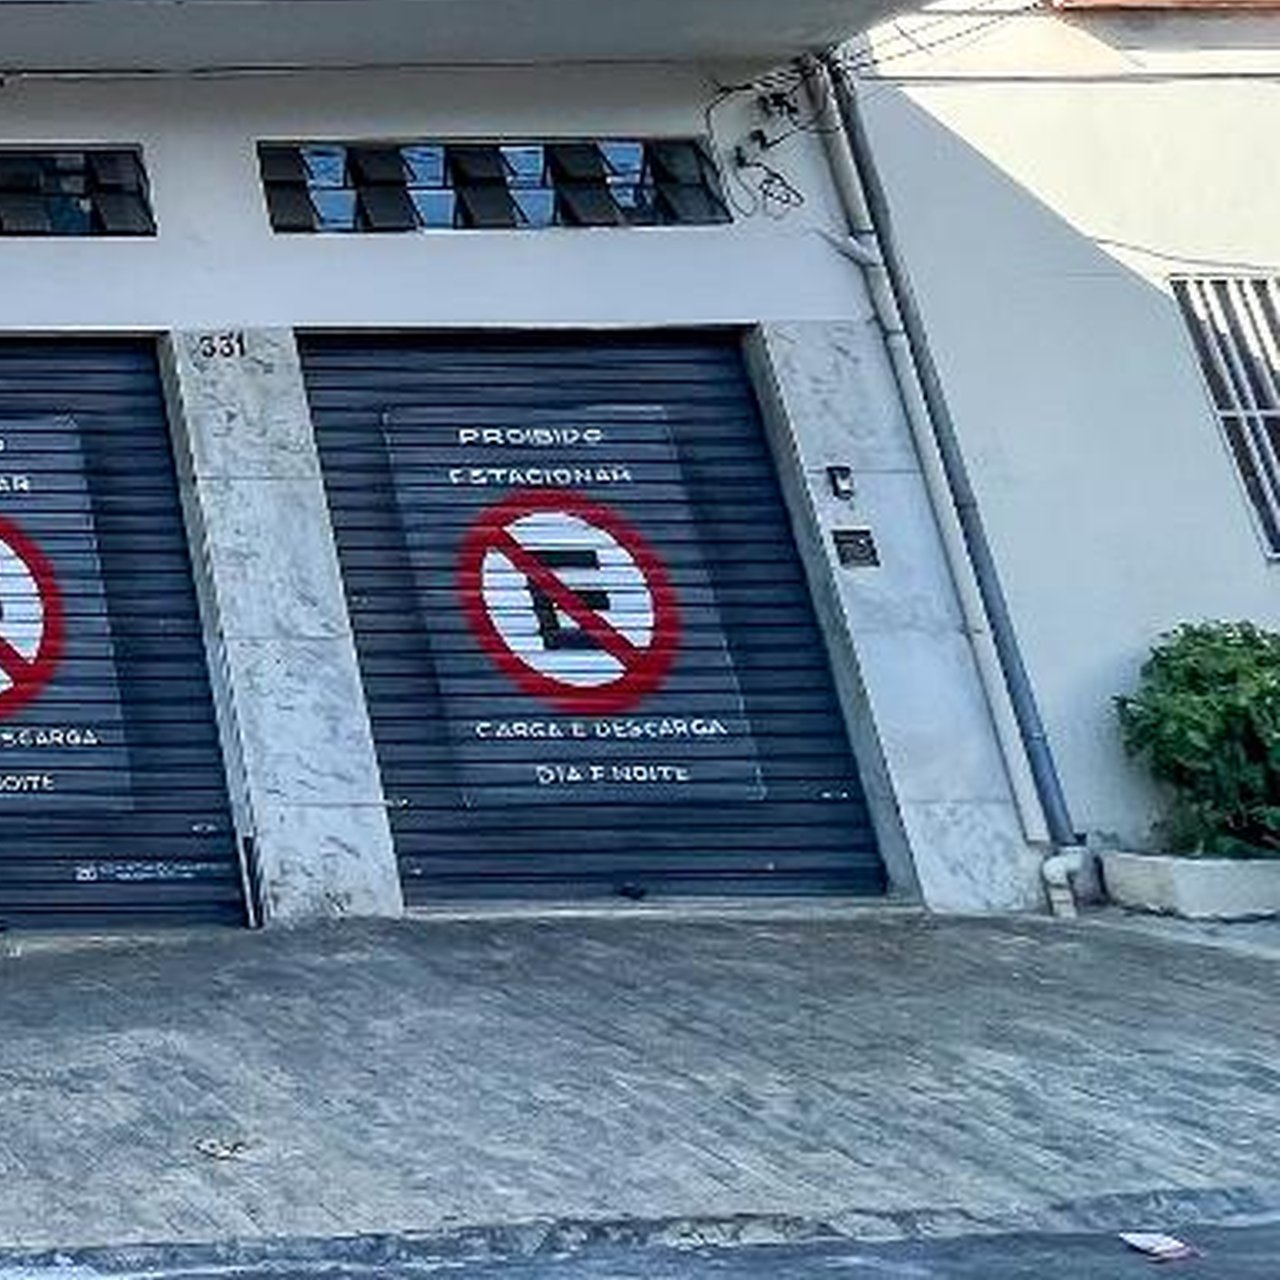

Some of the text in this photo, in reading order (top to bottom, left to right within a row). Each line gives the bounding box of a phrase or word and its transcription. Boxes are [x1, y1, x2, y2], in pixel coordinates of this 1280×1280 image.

[199, 329, 246, 358] 331
[458, 427, 604, 446] PROIBIDO
[448, 467, 632, 485] ESTACIONAR
[474, 721, 565, 739] CARGA
[594, 718, 730, 739] DESCARGA
[535, 764, 584, 785] DIA
[612, 764, 691, 783] NOITE
